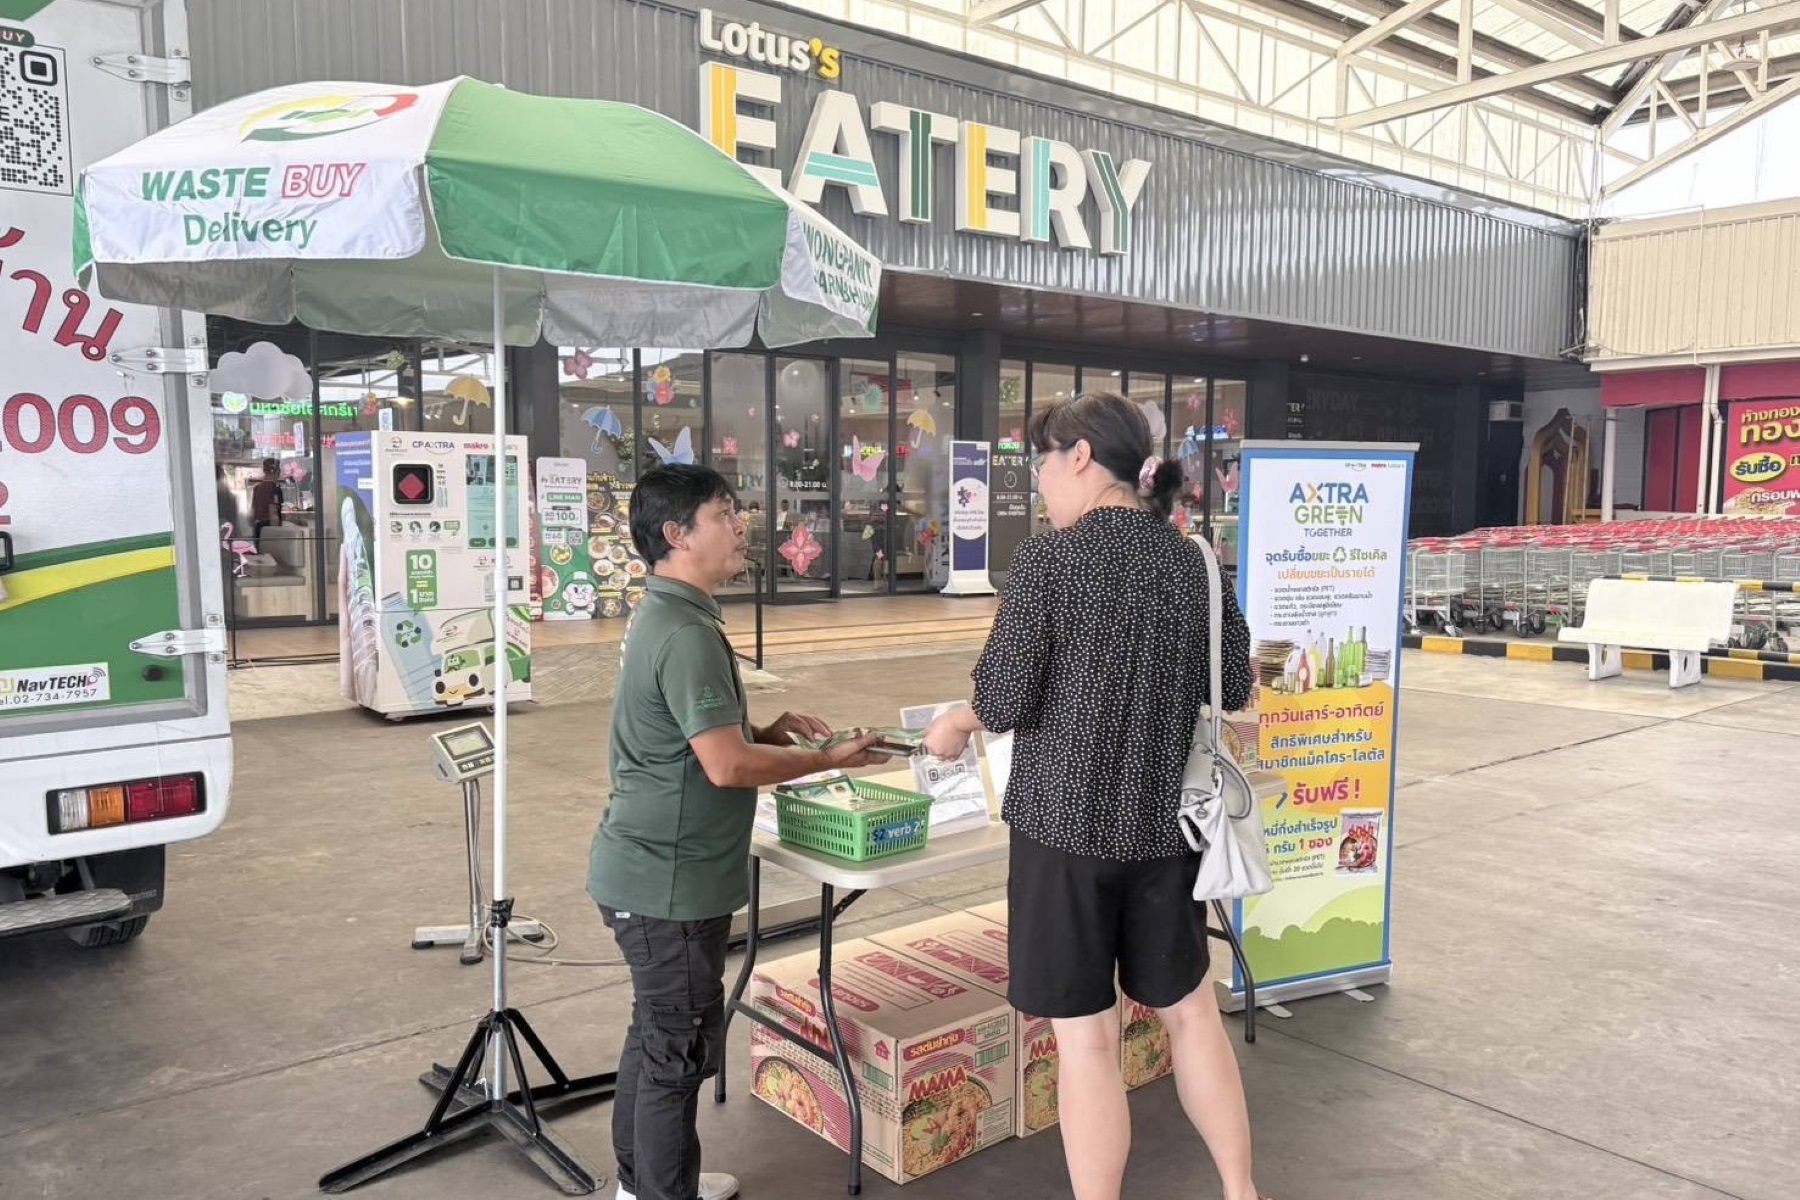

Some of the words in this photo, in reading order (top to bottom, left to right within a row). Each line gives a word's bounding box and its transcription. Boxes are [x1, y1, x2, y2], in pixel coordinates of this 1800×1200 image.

[0, 30, 25, 43] UY
[700, 9, 841, 80] Lotus's
[700, 61, 1152, 256] EATERY
[141, 167, 271, 201] WASTE
[281, 162, 366, 198] BUY
[183, 211, 319, 249] Delivery
[0, 392, 162, 454] 009
[1735, 454, 1781, 476] รับซื้อ
[1289, 482, 1369, 504] AXTRA
[1294, 505, 1363, 525] GREEN
[1304, 528, 1352, 537] TOGETHER
[409, 554, 433, 570] 10
[17, 675, 87, 693] NavTECH
[1293, 777, 1348, 805] รับฟรี
[1274, 841, 1295, 854] กรัม
[1030, 1035, 1058, 1061] MA
[909, 1066, 967, 1101] MAMA
